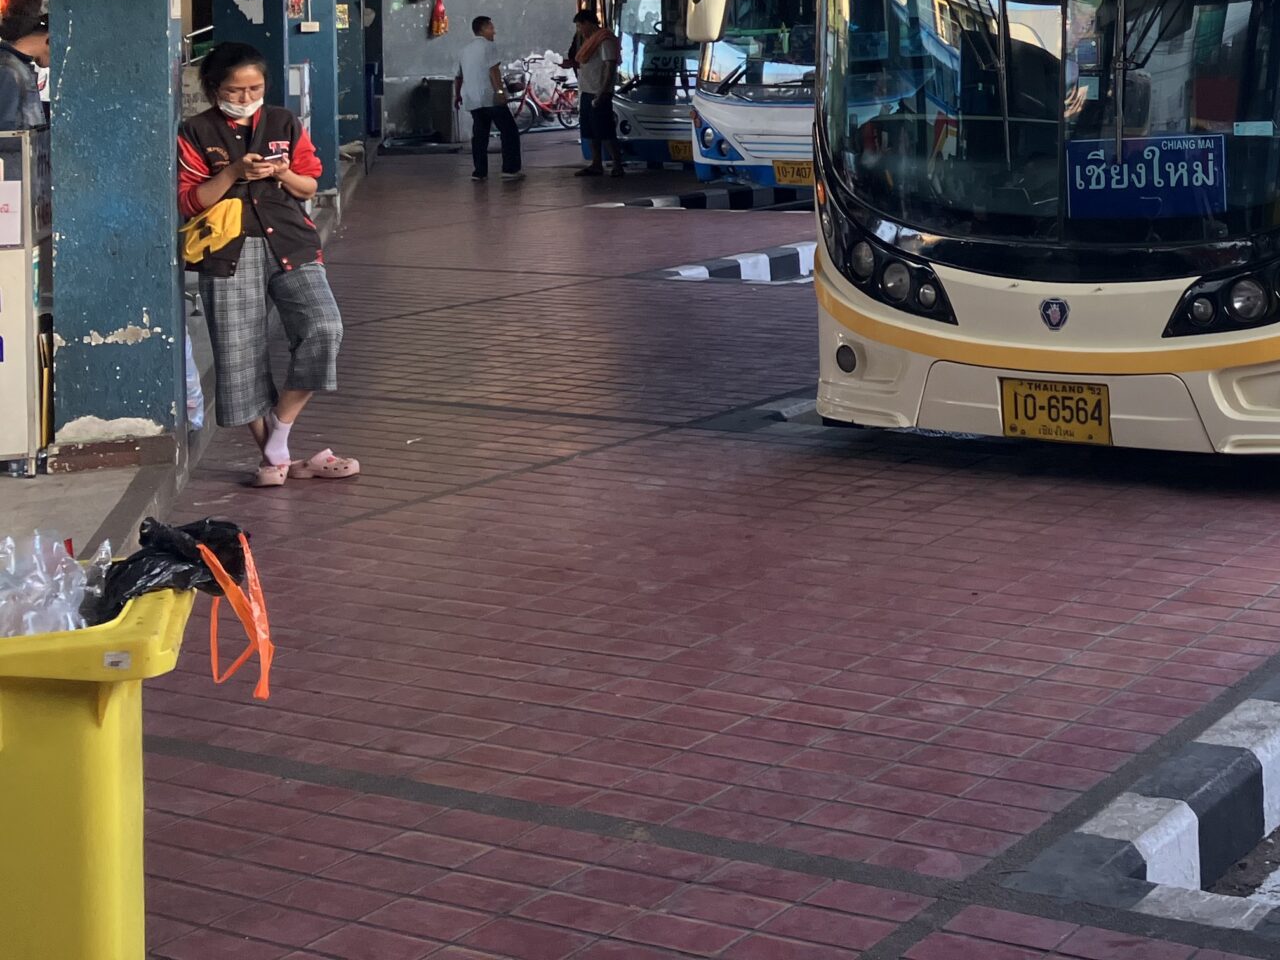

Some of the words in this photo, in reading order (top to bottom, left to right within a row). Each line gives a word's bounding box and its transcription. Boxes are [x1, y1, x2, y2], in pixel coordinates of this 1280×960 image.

[1161, 140, 1196, 151] CHIANG
[1197, 139, 1214, 150] MAI
[776, 165, 812, 179] 10-7407
[1075, 145, 1215, 190] เชียงใหม่
[1027, 382, 1084, 394] THAILAND
[1014, 391, 1103, 426] 10-6564
